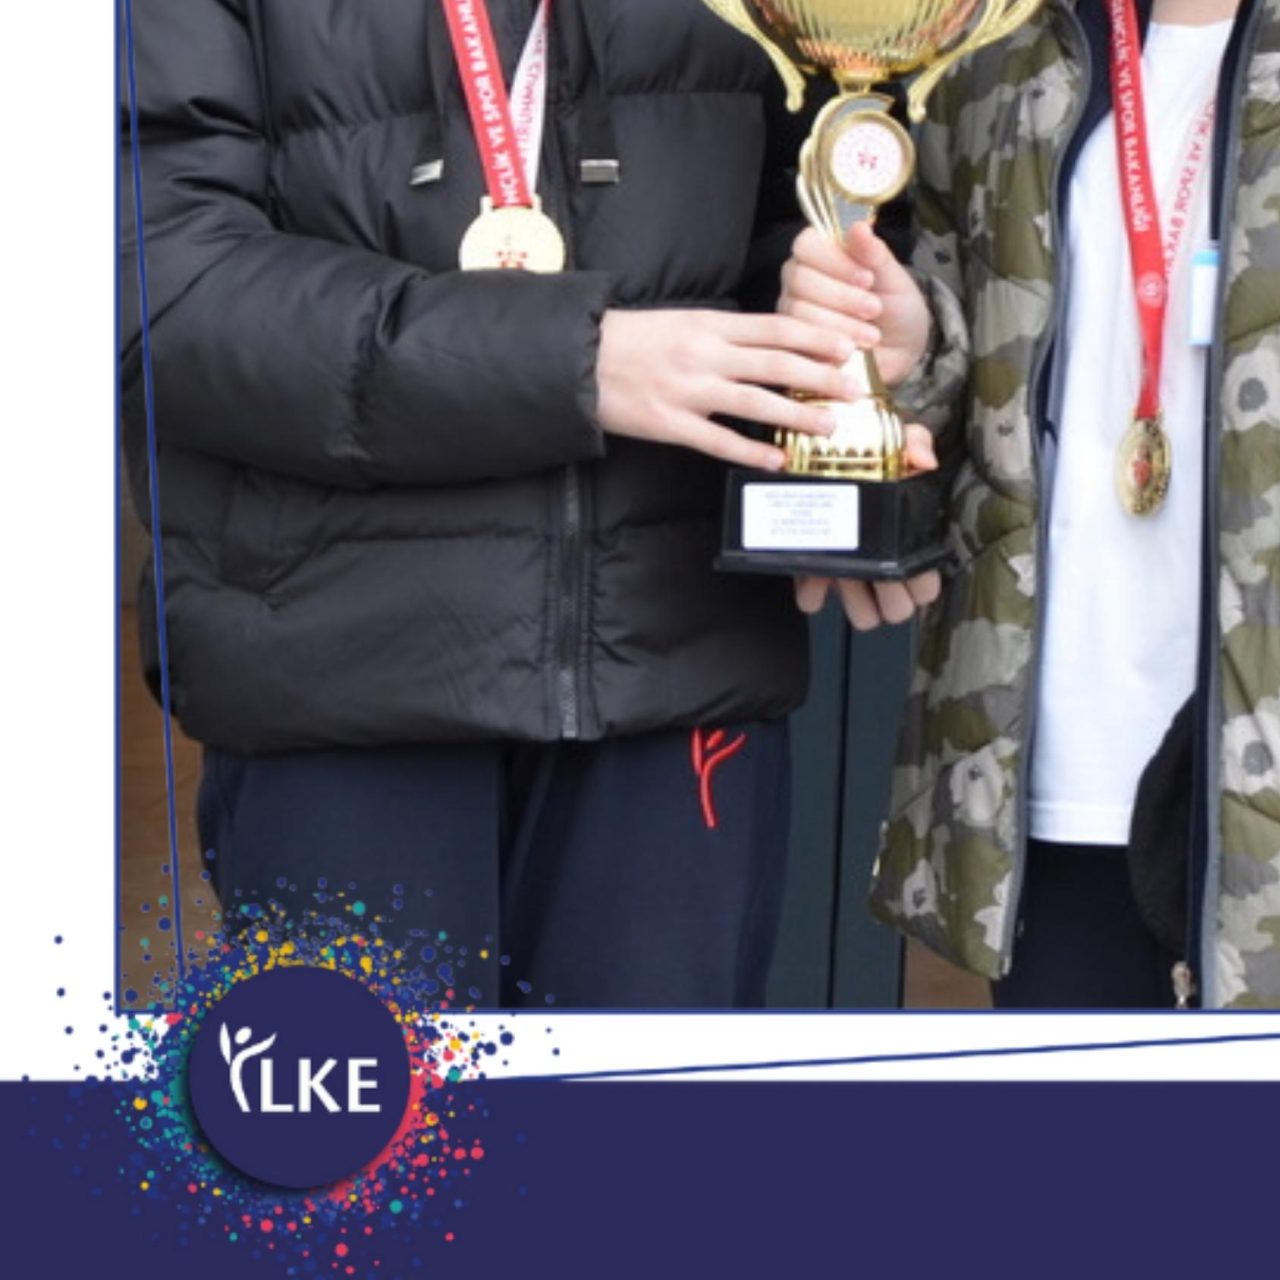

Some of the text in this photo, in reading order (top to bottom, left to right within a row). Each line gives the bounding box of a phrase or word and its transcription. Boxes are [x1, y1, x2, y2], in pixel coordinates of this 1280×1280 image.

[474, 75, 502, 123] SPOR
[487, 125, 506, 149] VE
[491, 151, 521, 205] NÇLİK
